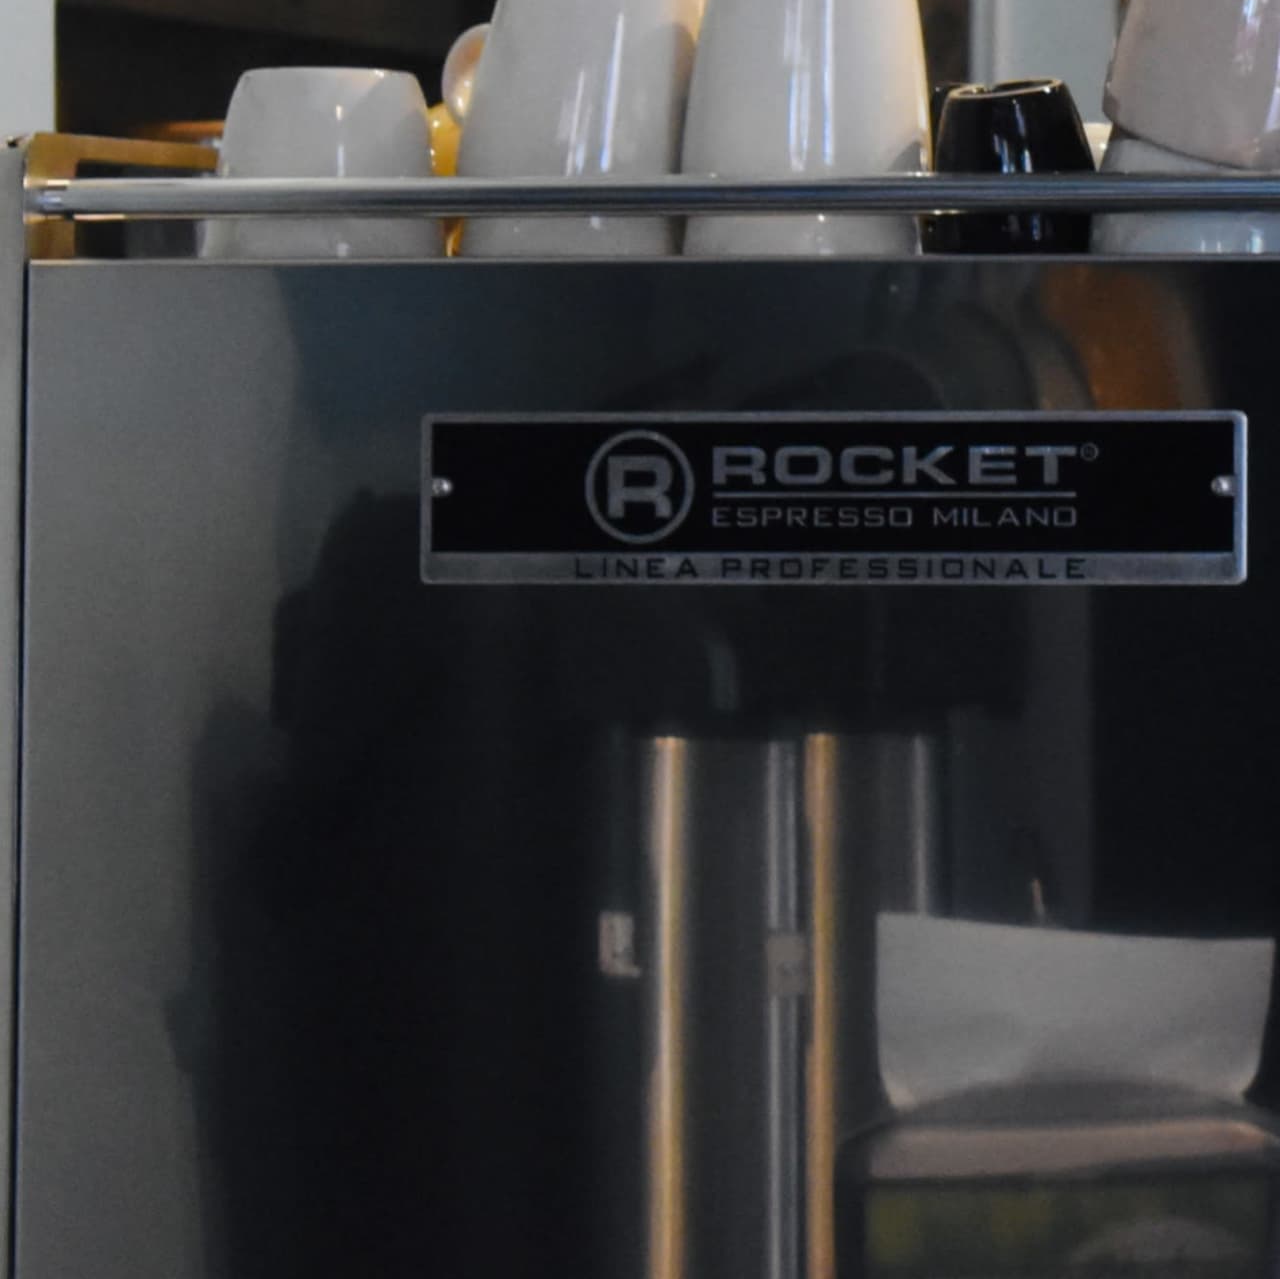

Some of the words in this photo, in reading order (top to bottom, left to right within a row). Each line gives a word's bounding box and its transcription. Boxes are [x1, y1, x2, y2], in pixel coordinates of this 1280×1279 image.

[711, 445, 1077, 486] ROCKET
[711, 506, 913, 528] ESPRESSO
[932, 506, 1077, 528] MILANO
[575, 558, 698, 580] LINEA
[720, 558, 1088, 580] PROFESSIONALE
